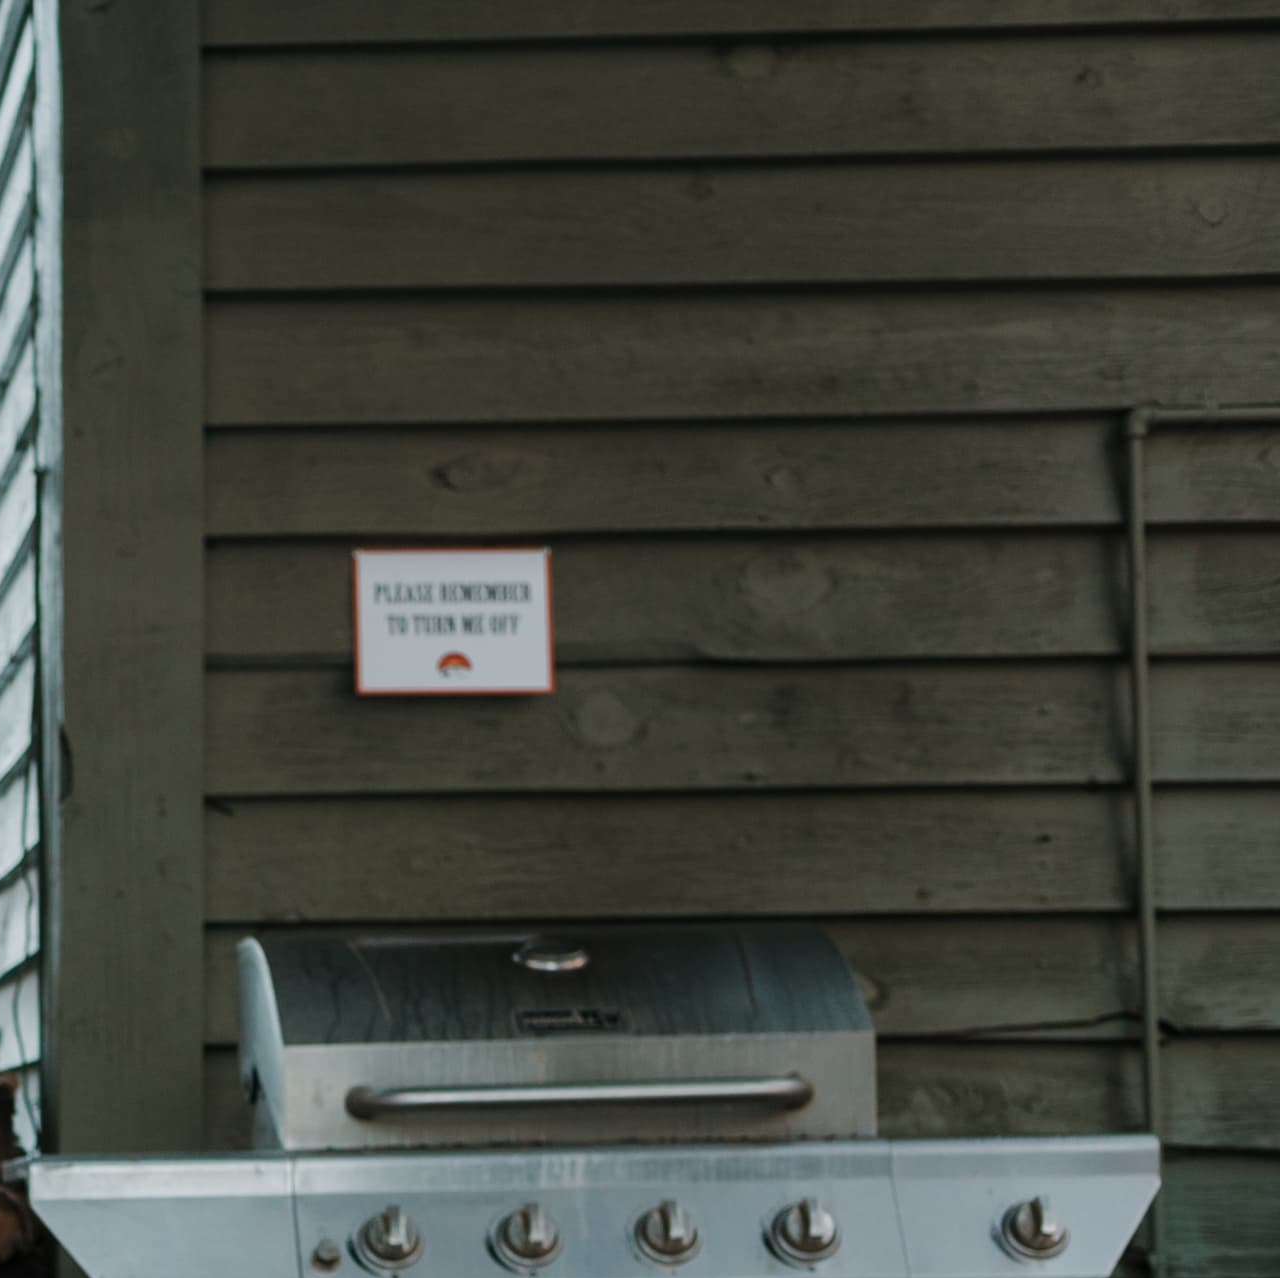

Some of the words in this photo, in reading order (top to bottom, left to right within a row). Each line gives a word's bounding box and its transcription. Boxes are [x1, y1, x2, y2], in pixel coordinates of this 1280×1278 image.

[374, 583, 433, 603] PLEASE
[440, 583, 531, 602] REMEMBER
[387, 615, 407, 634] TO
[413, 615, 456, 635] TURN
[462, 615, 484, 634] ME
[489, 615, 519, 634] OFF
